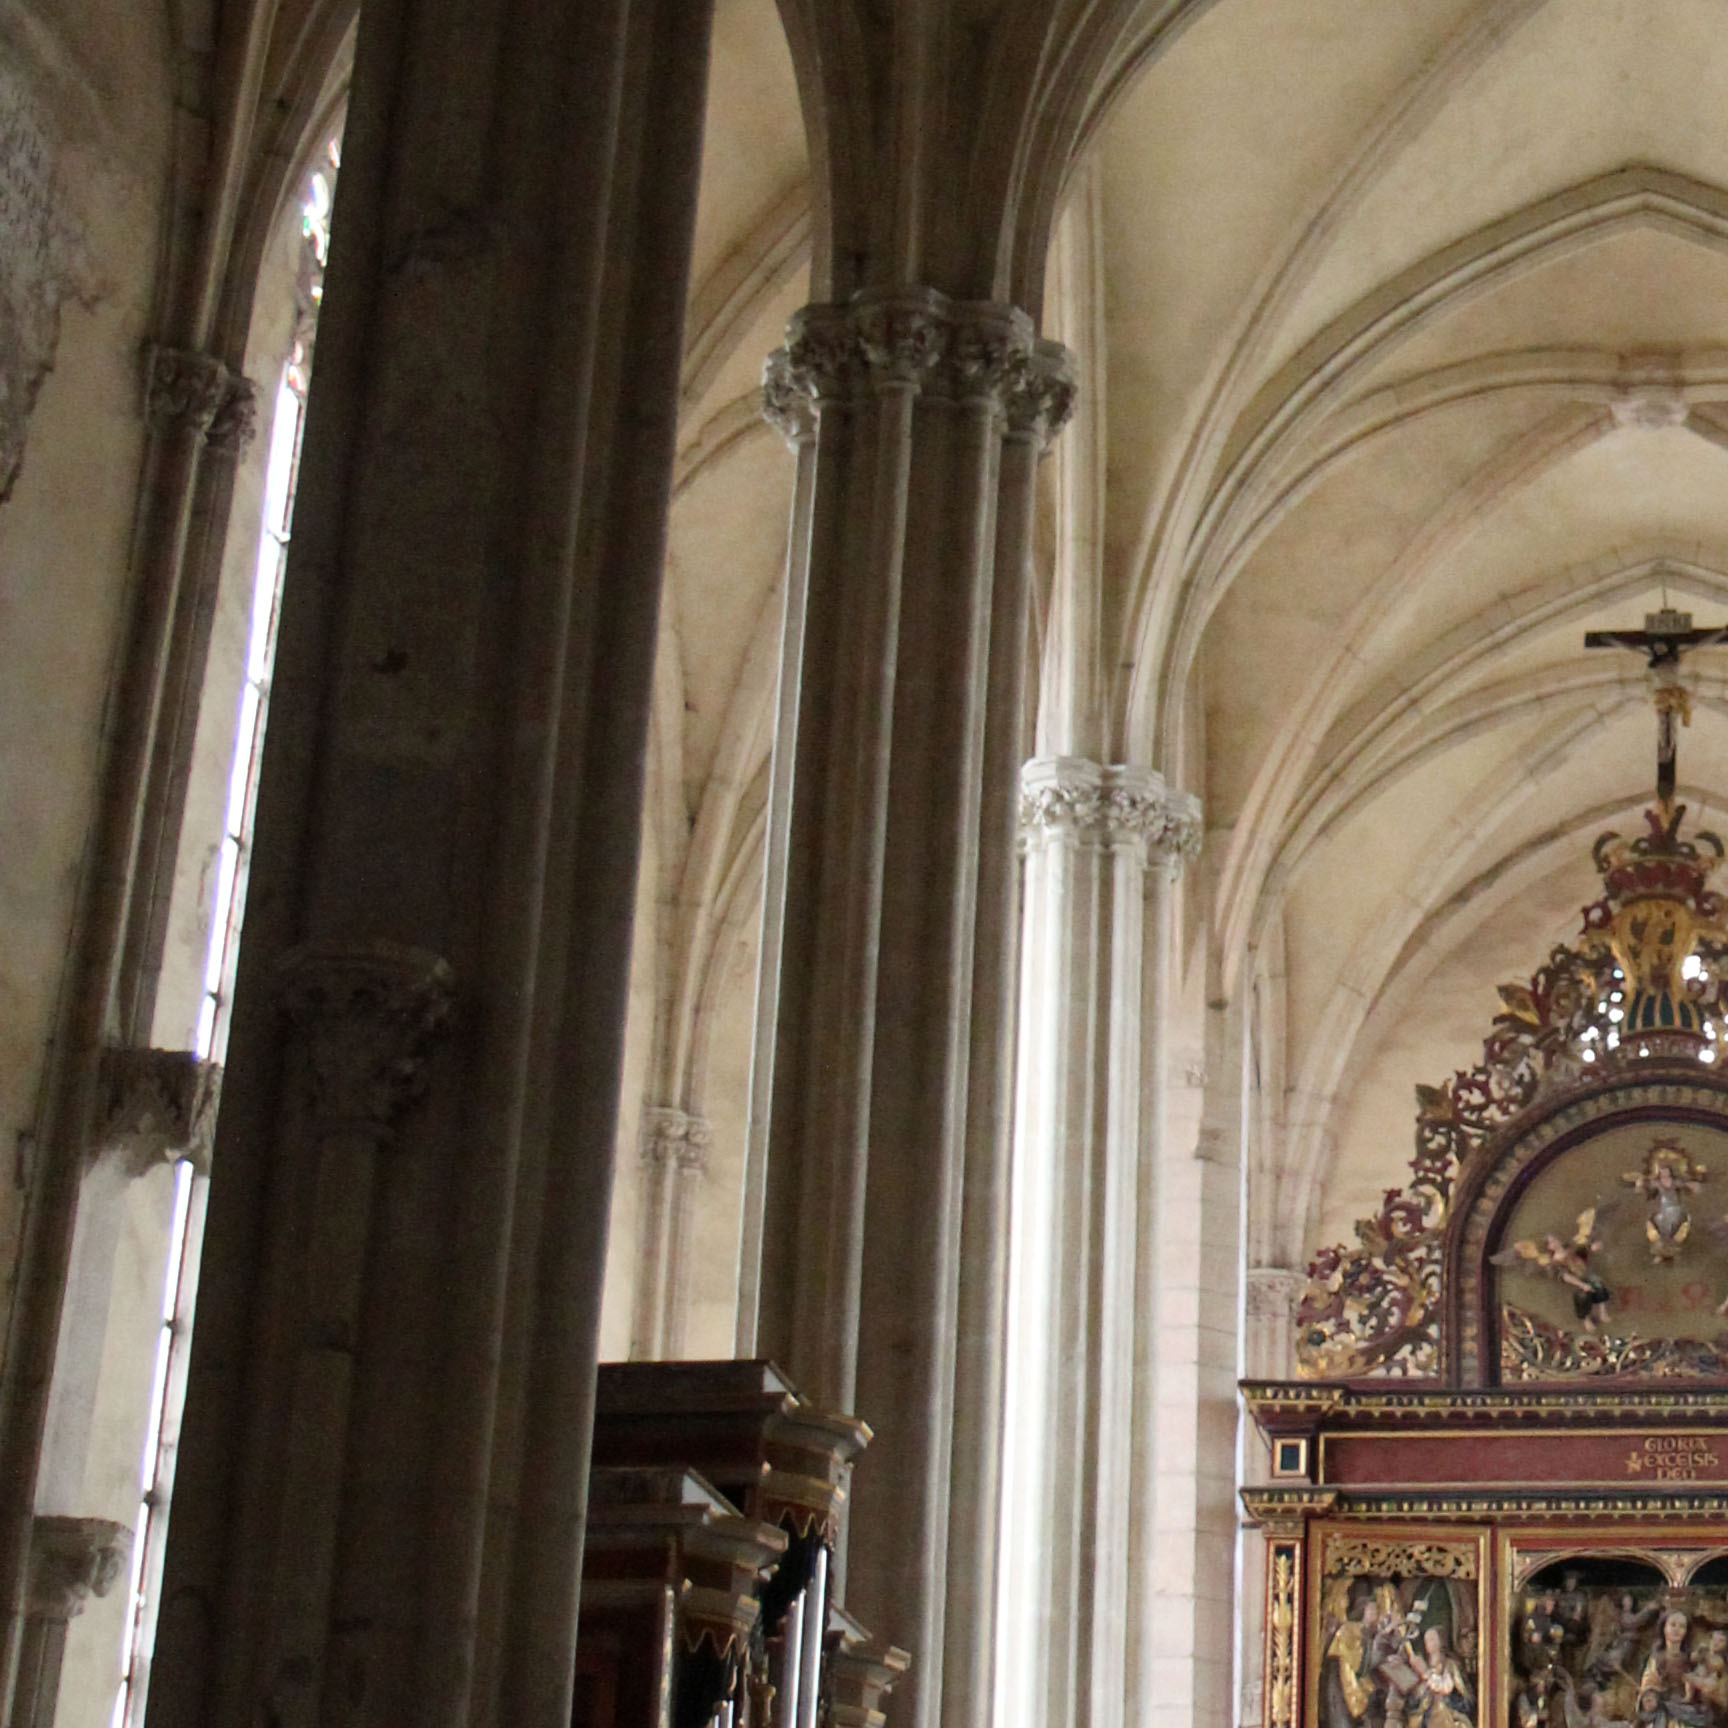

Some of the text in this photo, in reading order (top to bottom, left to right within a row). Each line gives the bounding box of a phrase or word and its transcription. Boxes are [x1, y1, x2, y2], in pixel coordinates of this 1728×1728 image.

[1644, 1437, 1708, 1452] GLORIA
[1644, 1452, 1719, 1468] EXCELSIS
[1657, 1467, 1696, 1481] DEO
